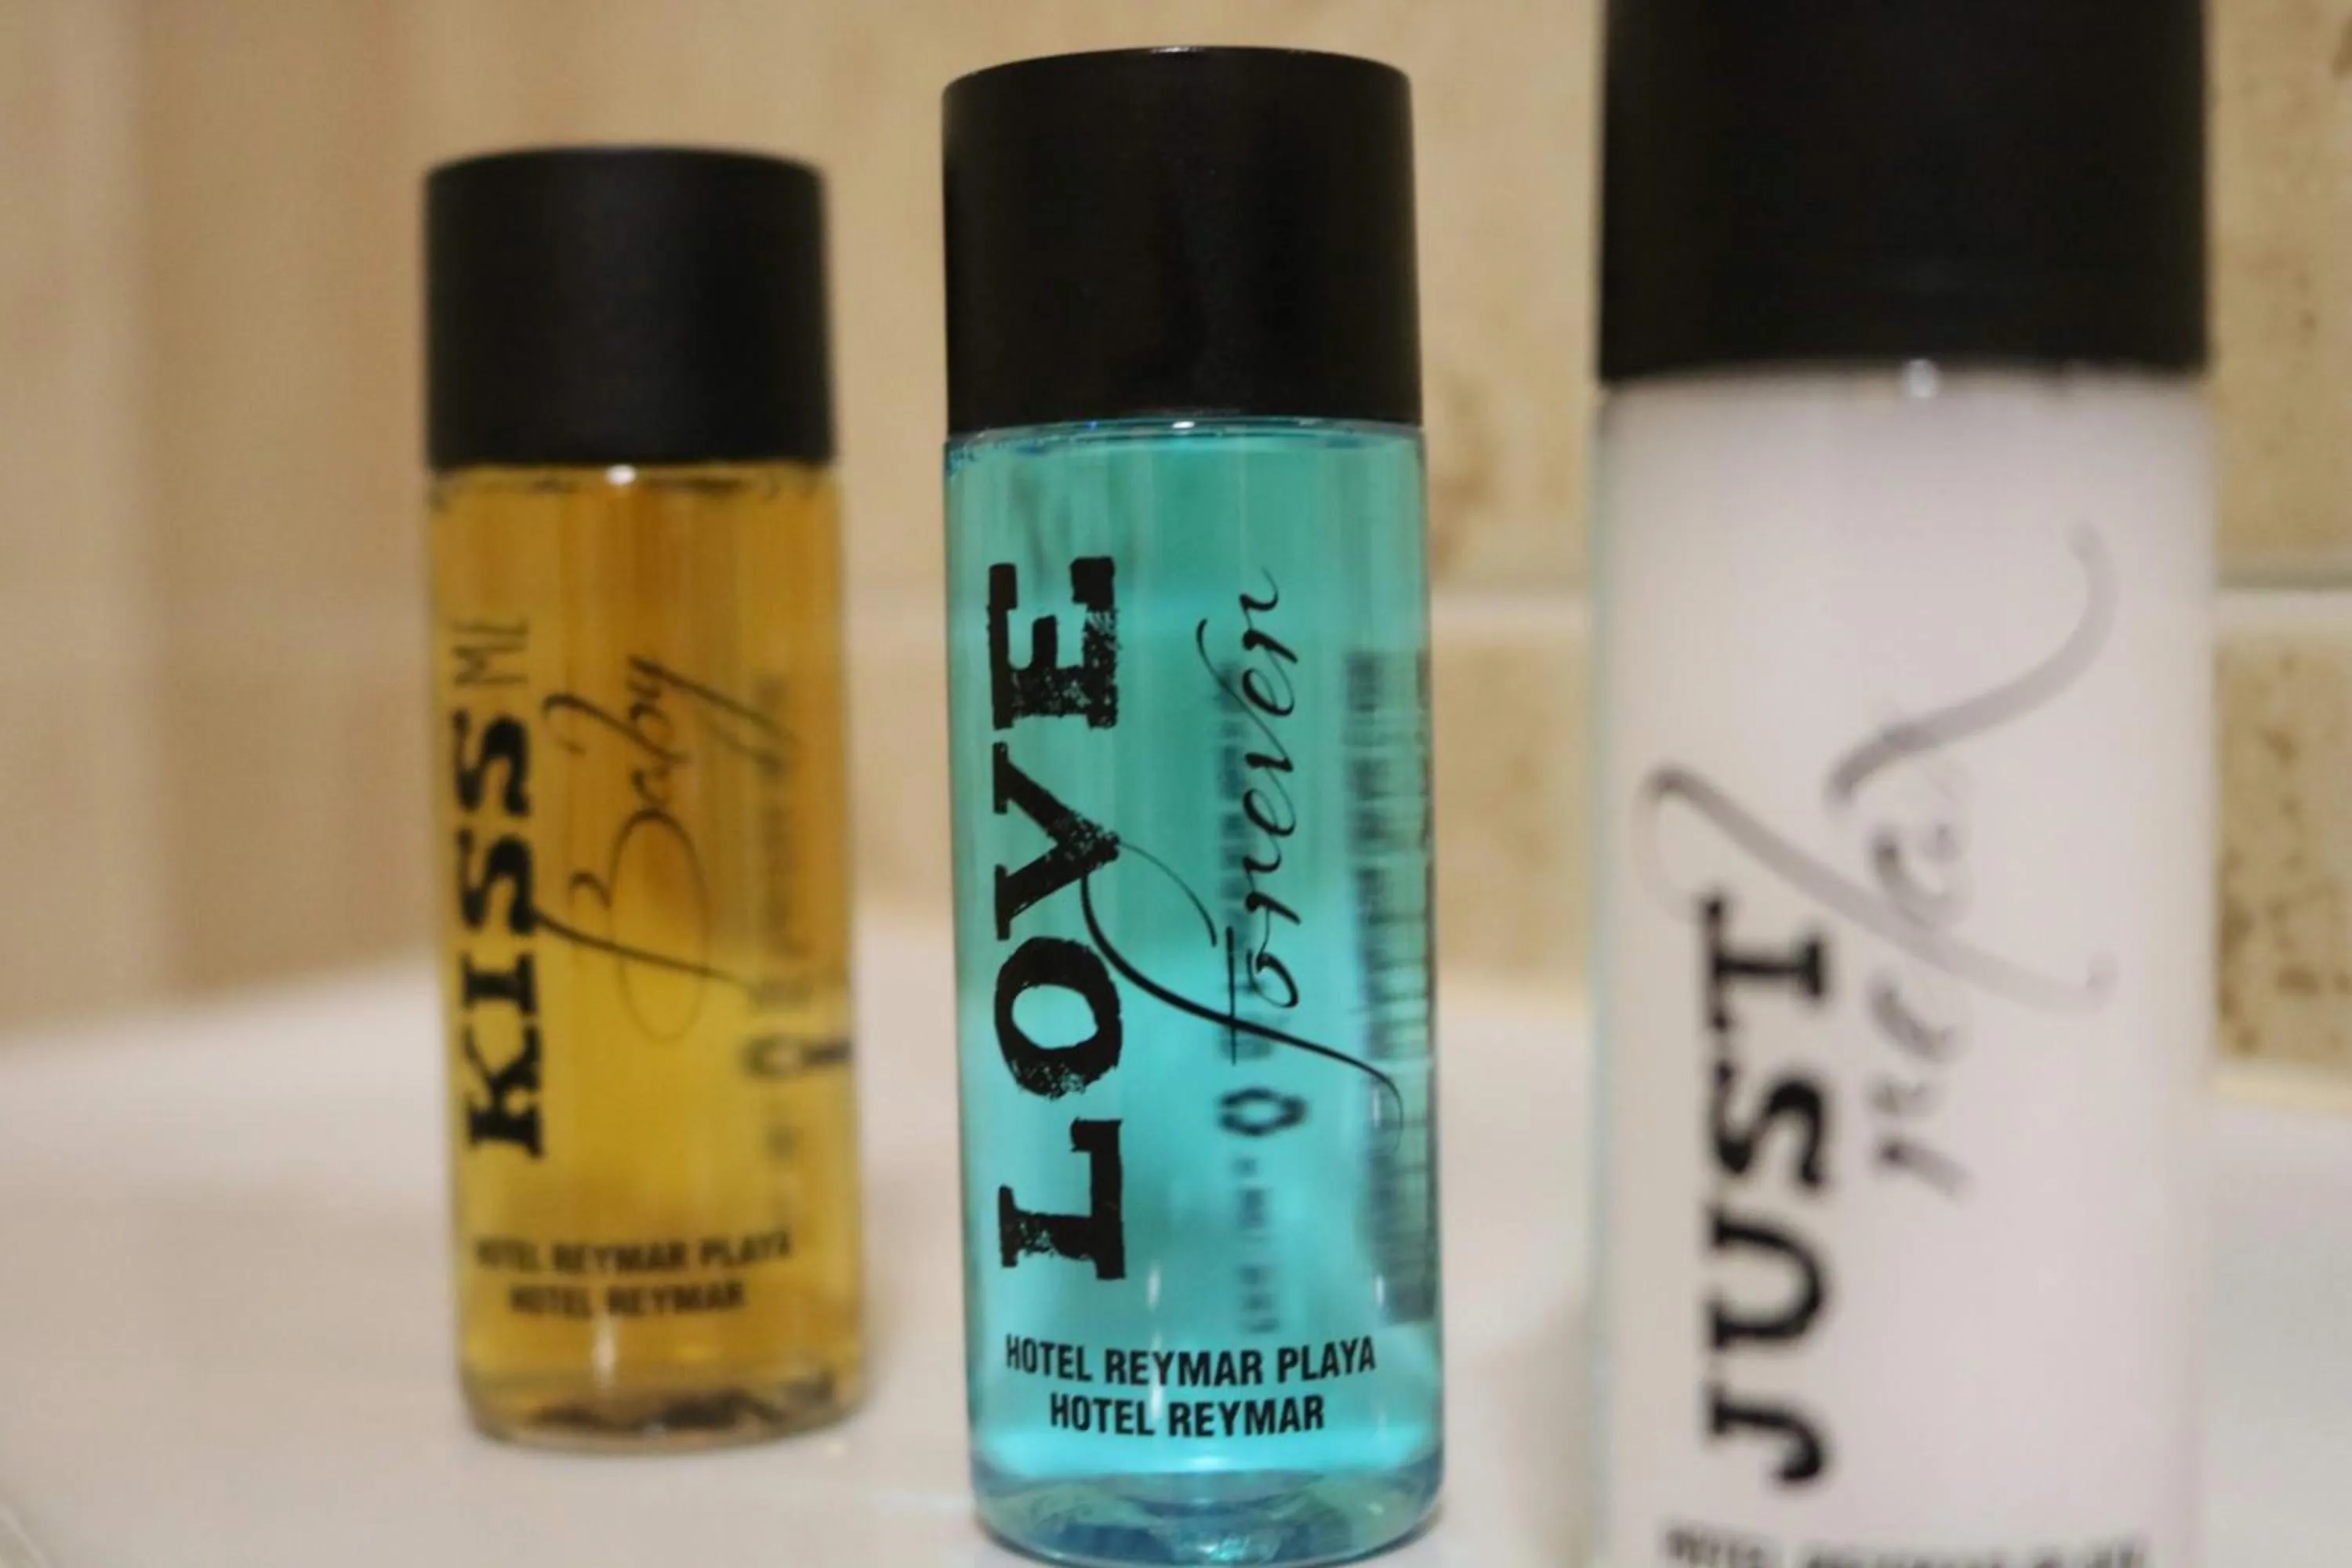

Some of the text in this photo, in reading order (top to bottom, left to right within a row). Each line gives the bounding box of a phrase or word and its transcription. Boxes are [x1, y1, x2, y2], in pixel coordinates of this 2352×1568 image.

[453, 709, 546, 1160] KISS
[986, 555, 1127, 1280] LOVE
[1079, 566, 1404, 1157] forever
[1006, 1334, 1376, 1386] HOTEL REYMAR PLAYA
[1050, 1392, 1324, 1437] HOTEL REYMAR
[1701, 894, 1828, 1484] JUST
